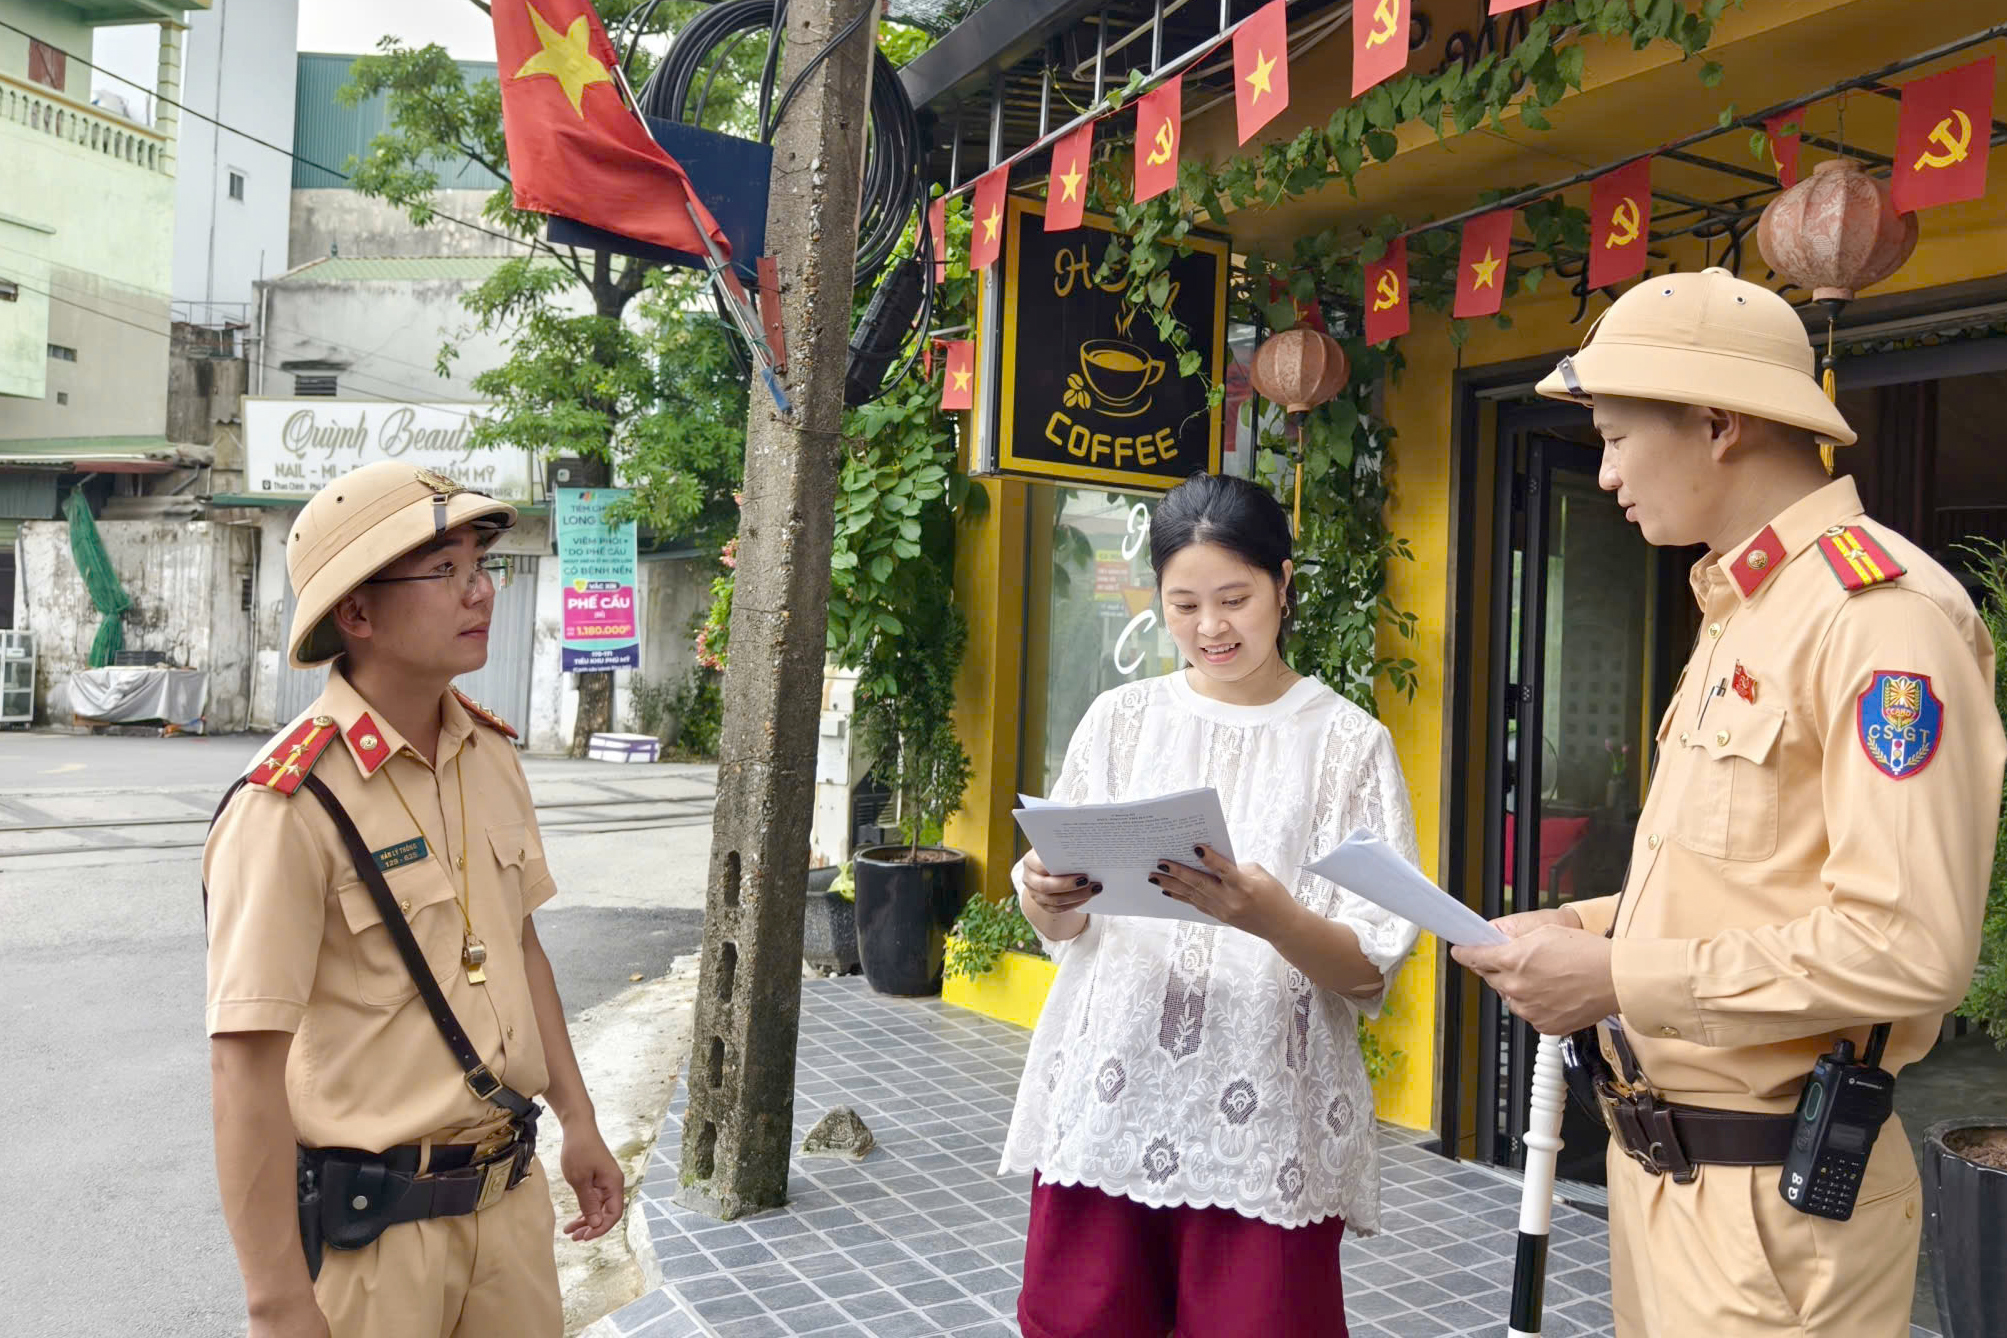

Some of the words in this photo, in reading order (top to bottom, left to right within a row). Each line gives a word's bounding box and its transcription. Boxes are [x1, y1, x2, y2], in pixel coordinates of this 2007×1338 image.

[282, 409, 368, 460] Quỳnh
[1045, 411, 1179, 467] COFFEE
[275, 463, 305, 478] NAIL
[321, 464, 337, 479] MI
[563, 515, 597, 526] LONG
[567, 593, 599, 610] PHẾ
[600, 593, 631, 609] CẦU
